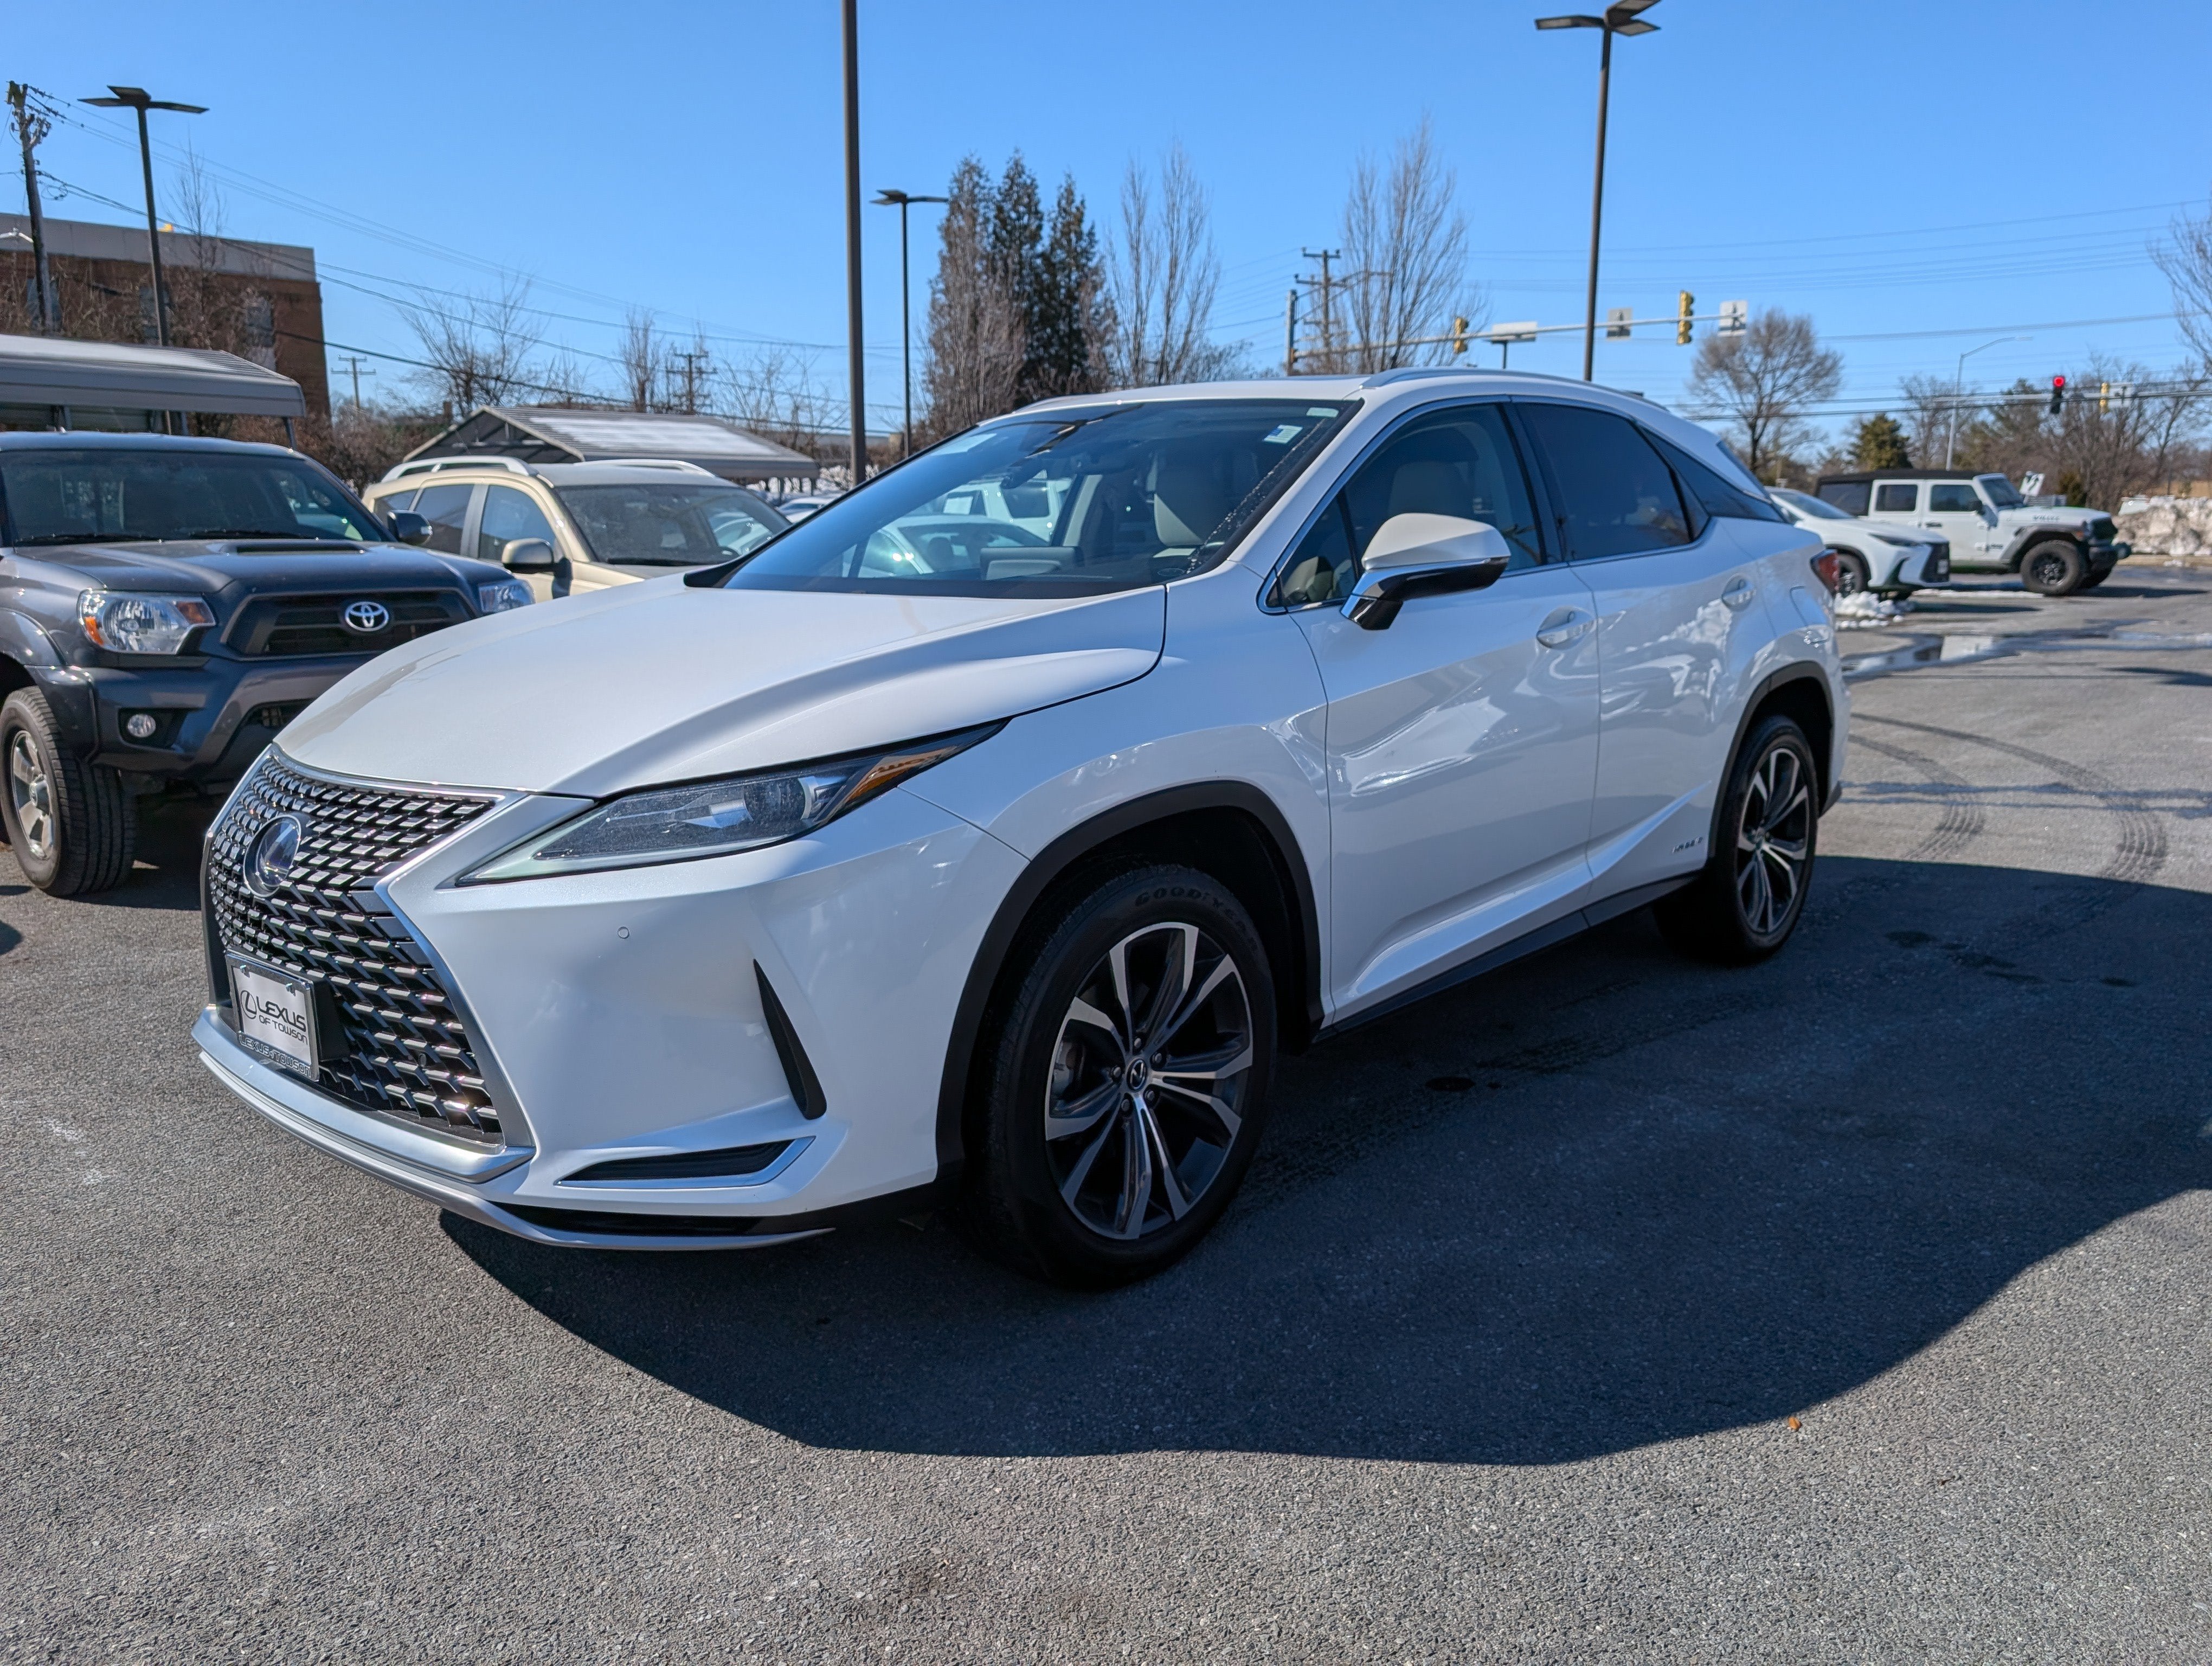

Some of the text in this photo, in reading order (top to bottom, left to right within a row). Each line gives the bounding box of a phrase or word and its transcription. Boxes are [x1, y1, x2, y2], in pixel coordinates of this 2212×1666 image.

[256, 996, 306, 1032] LEXUS
[259, 1015, 308, 1045] OF TOWSON
[239, 1035, 270, 1058] LEXUS
[273, 1050, 312, 1078] TOWSON
